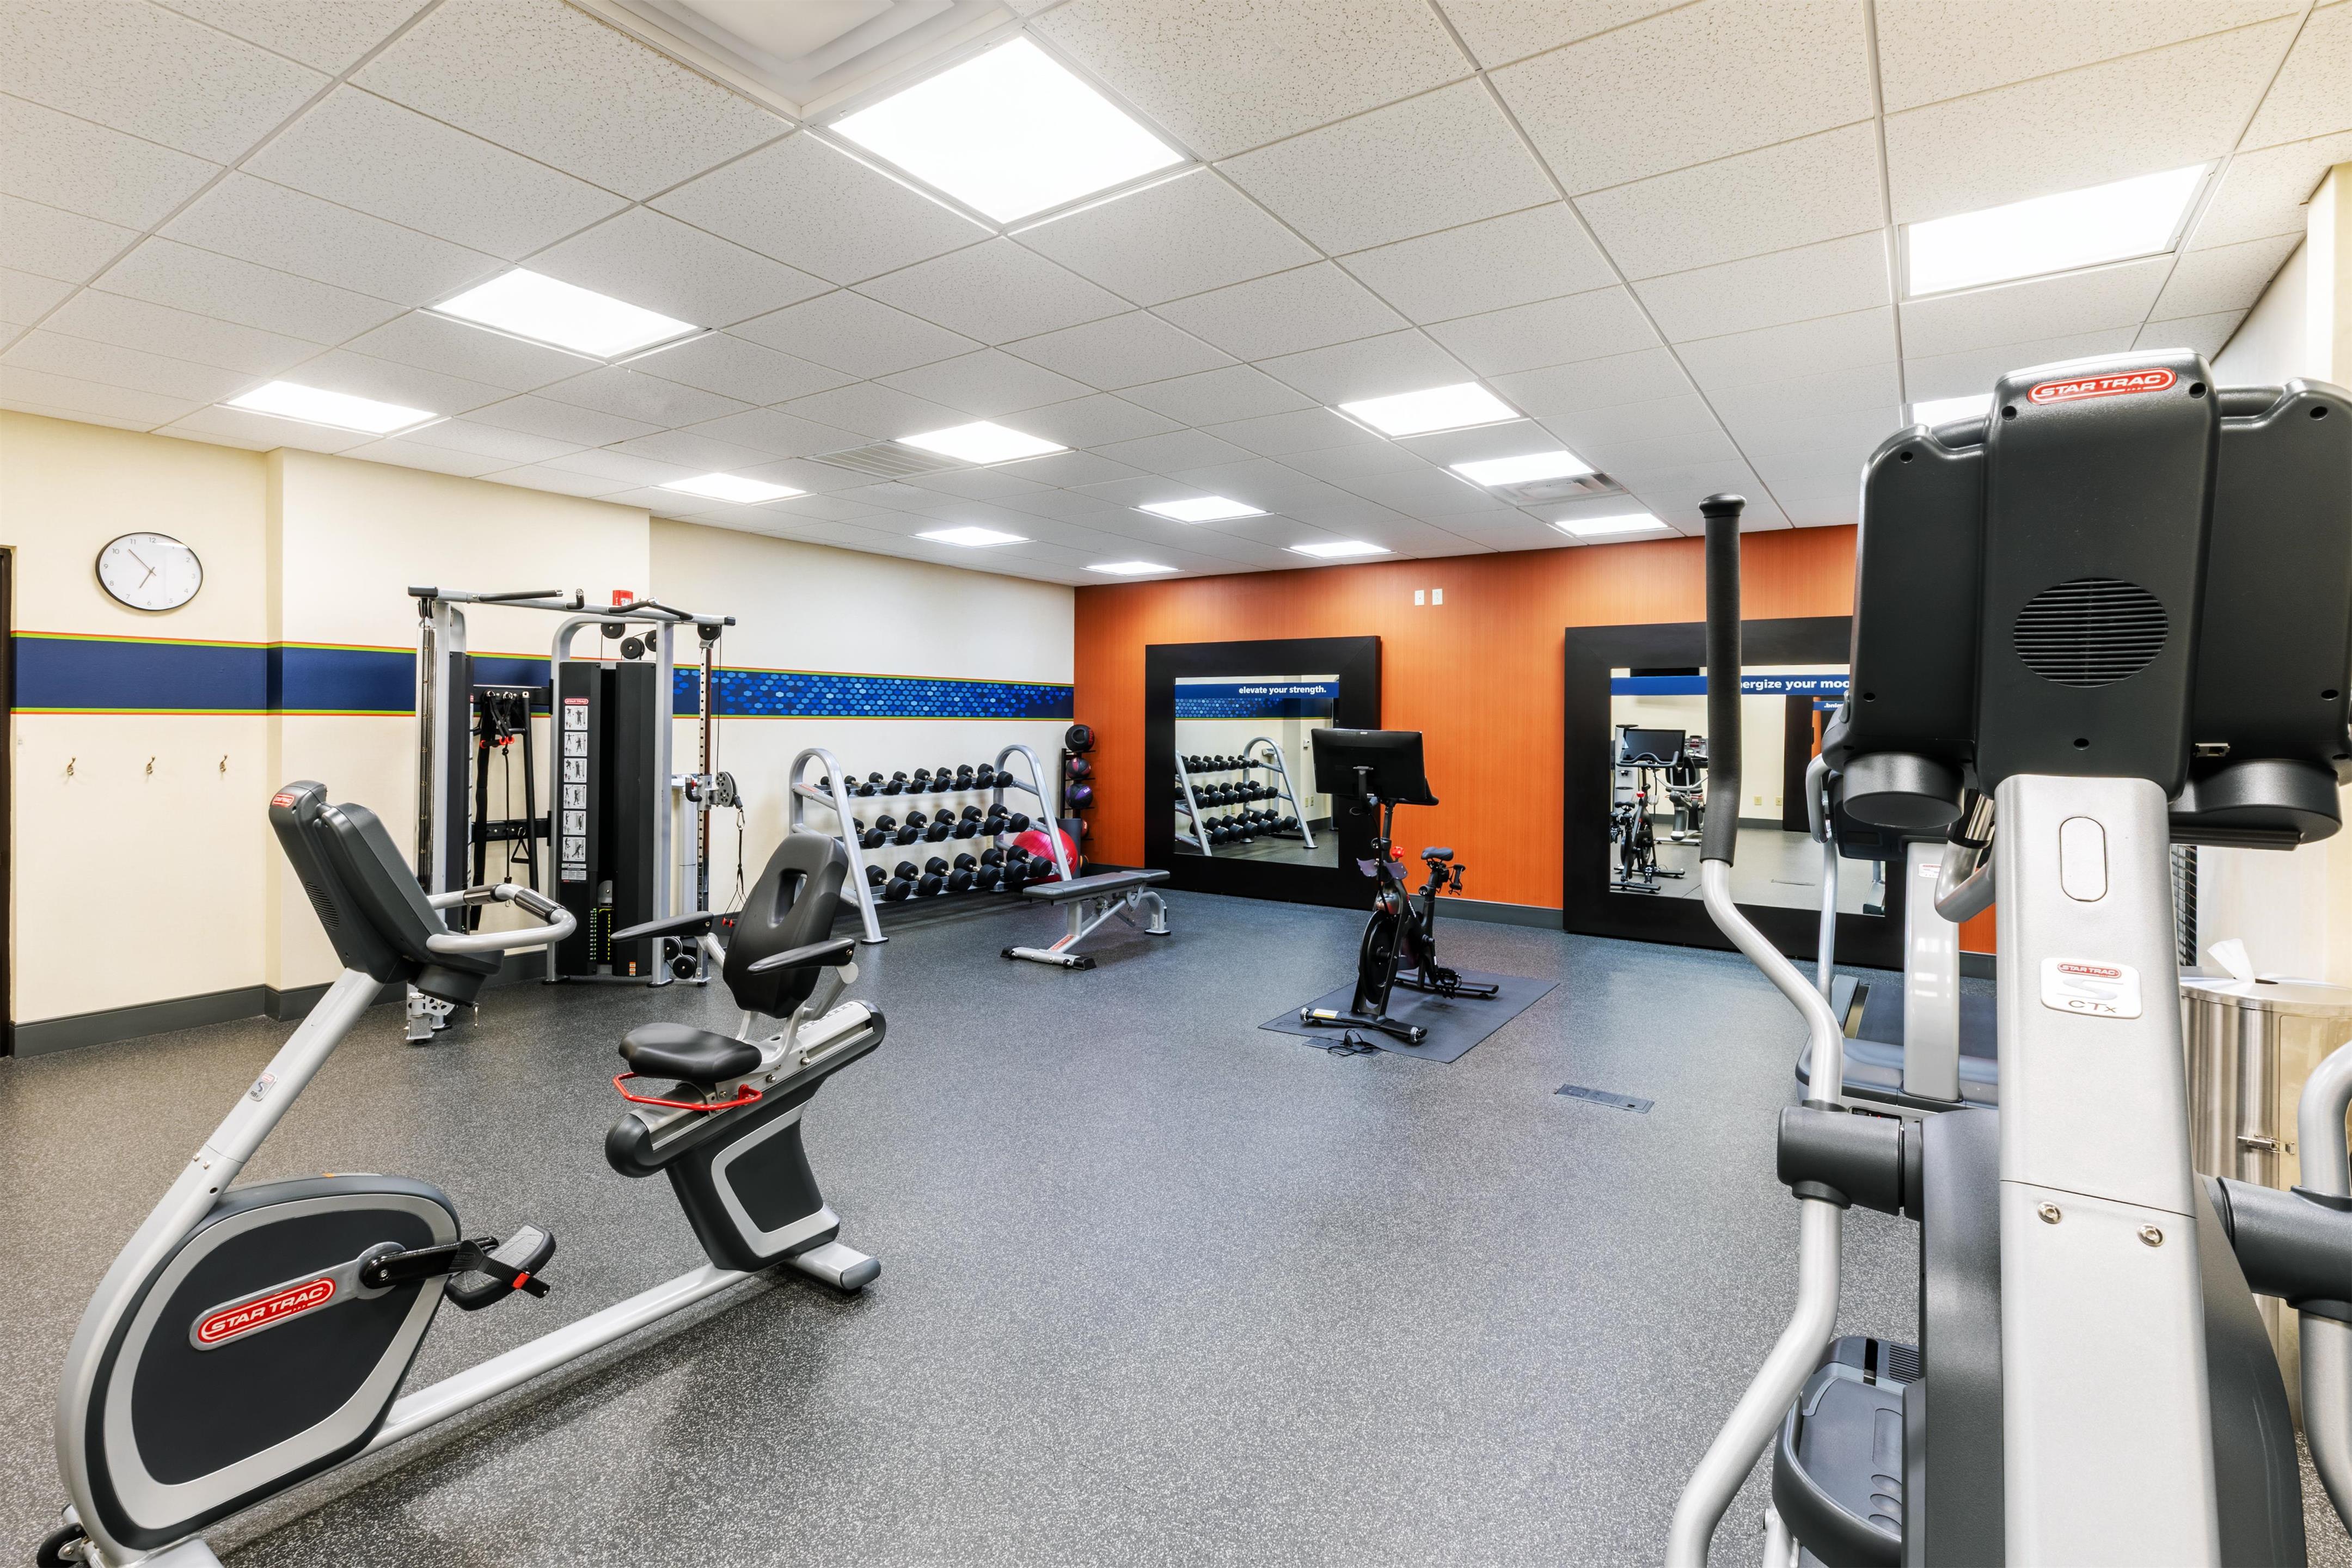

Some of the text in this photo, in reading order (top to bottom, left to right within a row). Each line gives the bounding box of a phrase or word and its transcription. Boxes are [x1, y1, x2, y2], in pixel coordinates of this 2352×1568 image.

[2041, 375, 2161, 396] STAR TRAC
[1269, 687, 1288, 695] your
[1289, 685, 1327, 695] strength.
[1741, 679, 1849, 691] ergize your moo
[211, 1287, 324, 1331] STAR TRAC
